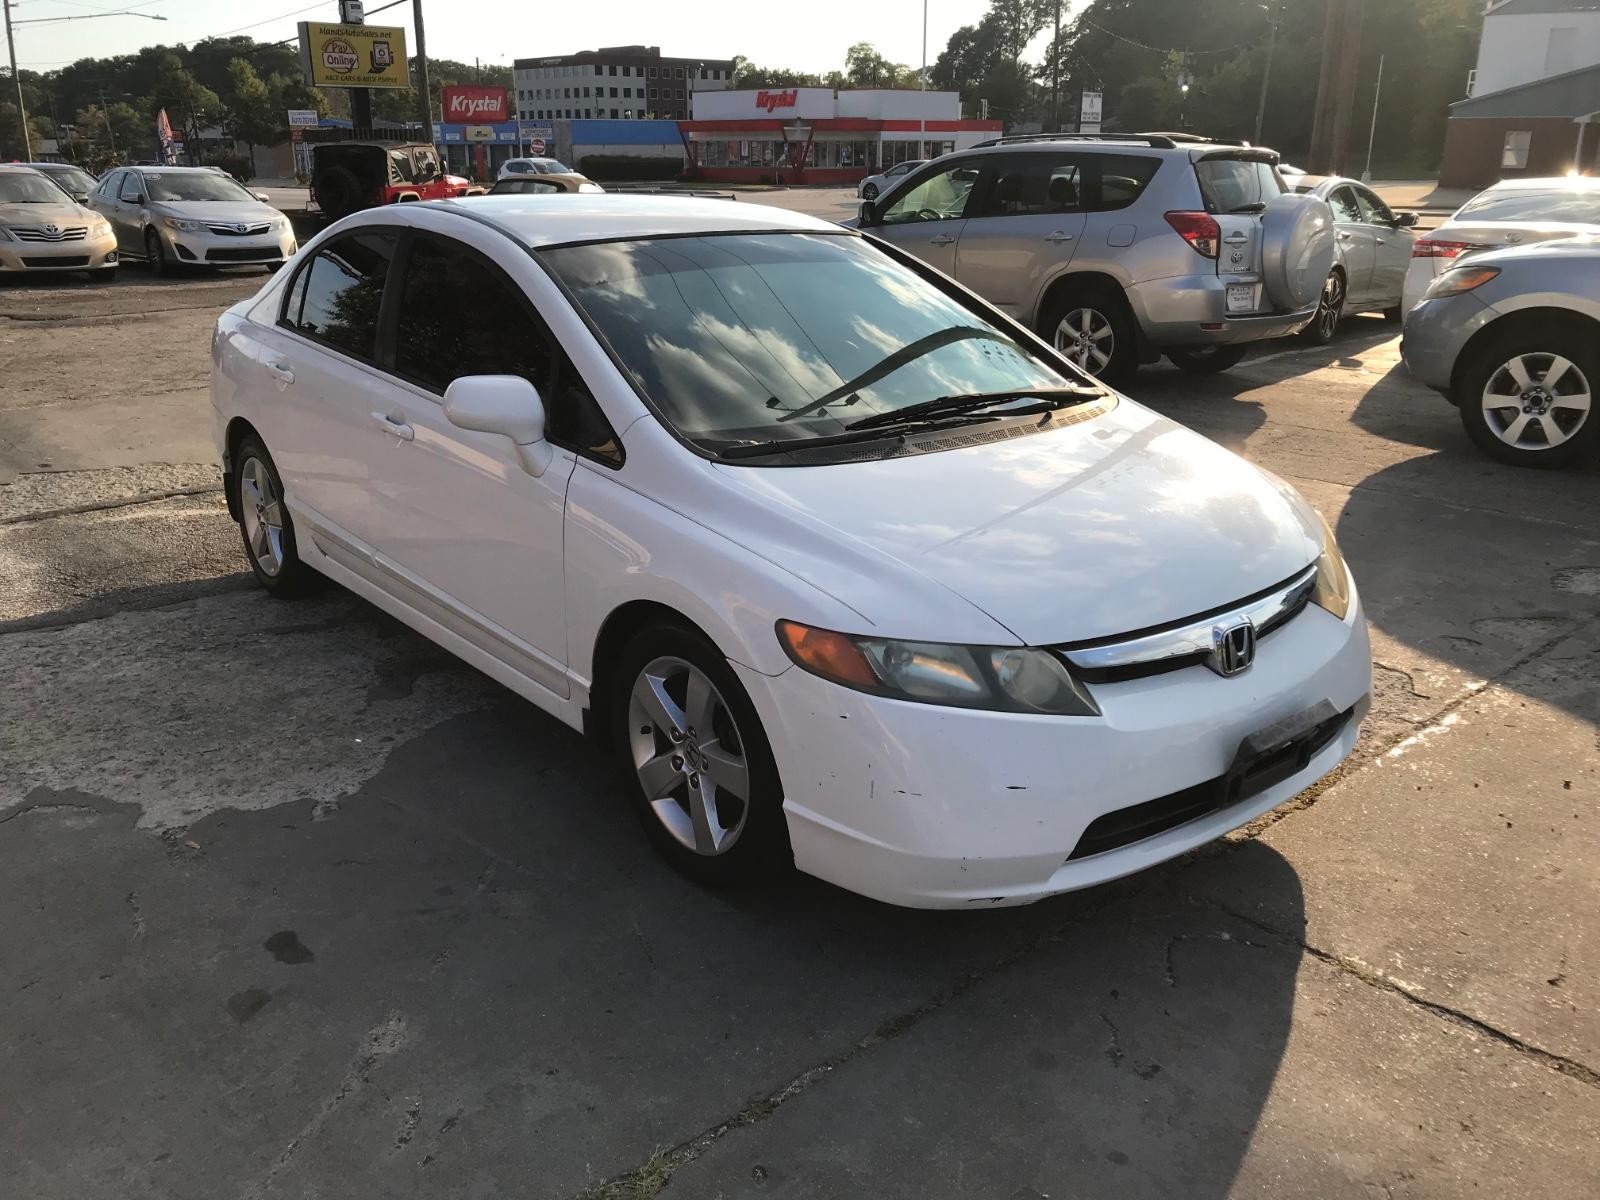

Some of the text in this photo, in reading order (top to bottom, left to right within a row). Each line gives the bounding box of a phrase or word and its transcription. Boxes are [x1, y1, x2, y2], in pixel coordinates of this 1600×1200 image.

[332, 42, 348, 54] Pay
[327, 54, 354, 66] Online
[451, 95, 502, 117] Krystal
[756, 90, 798, 113] Krystal
